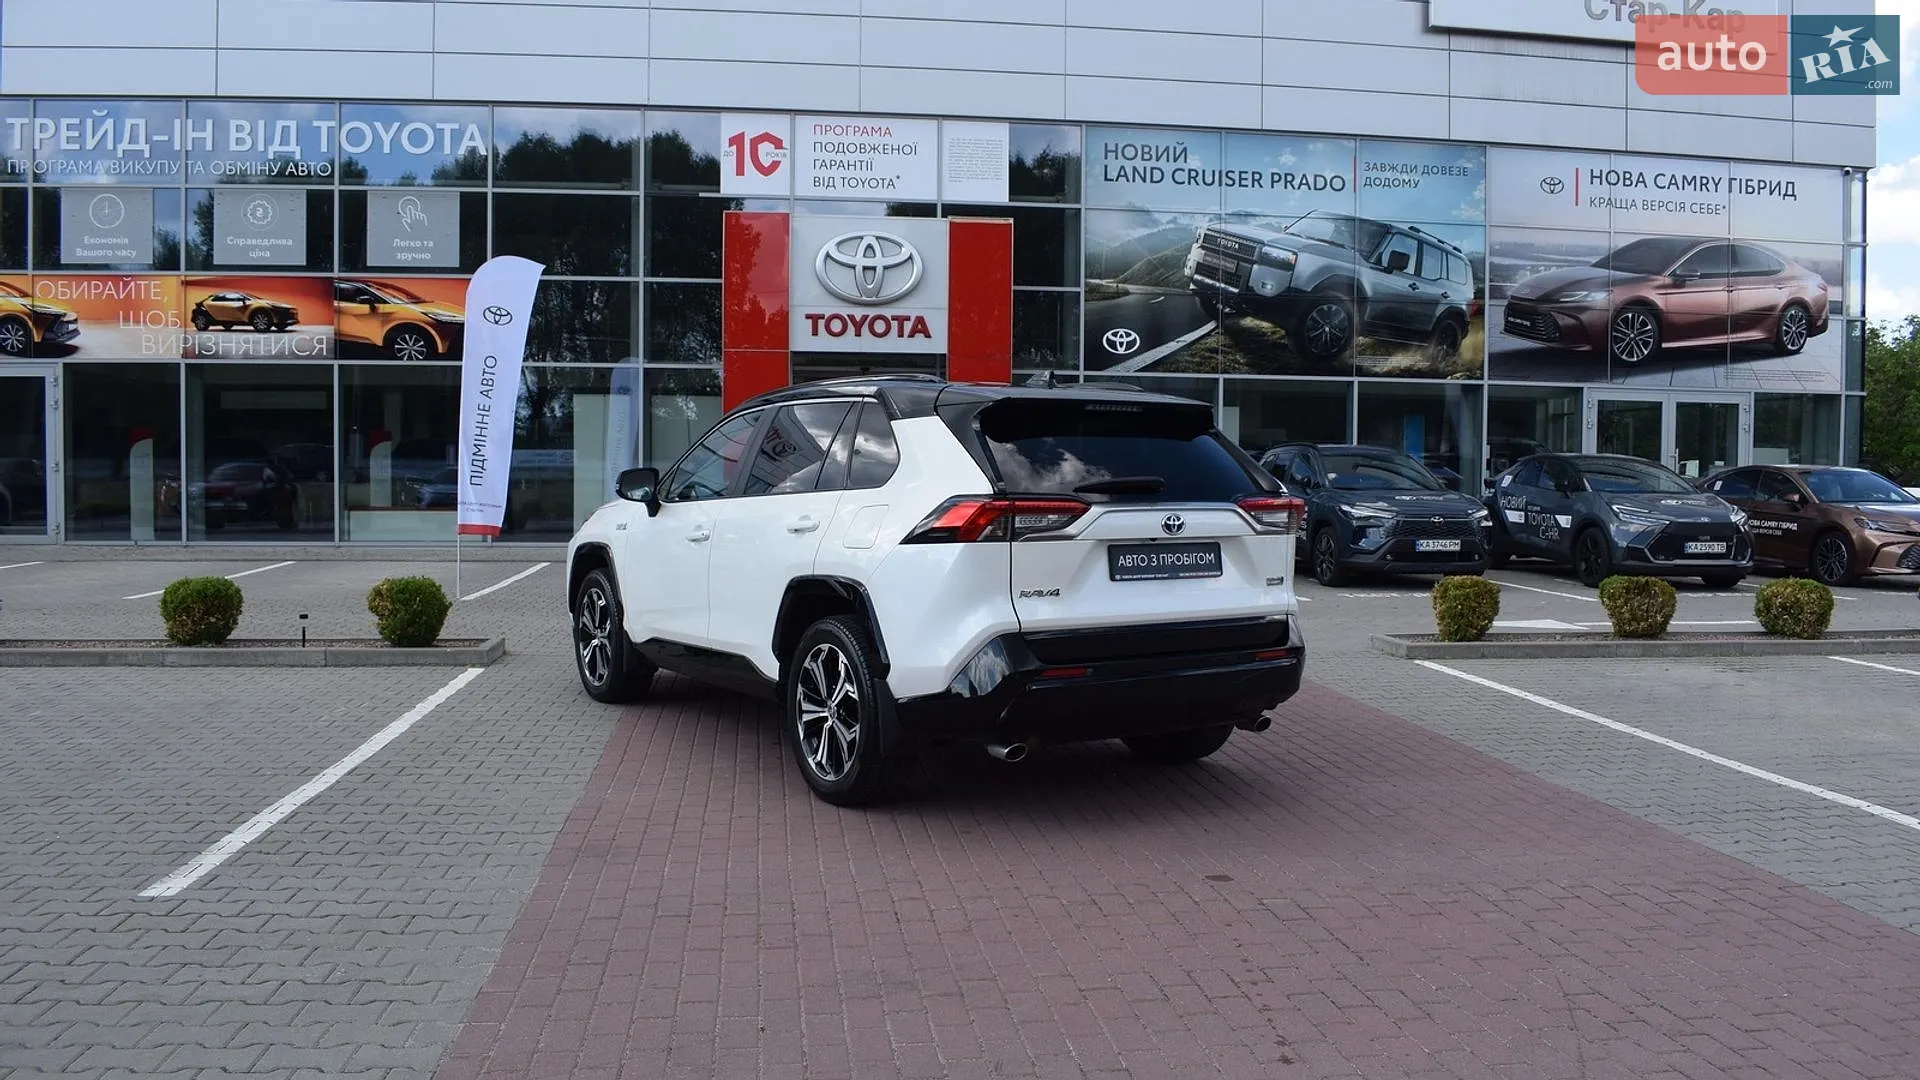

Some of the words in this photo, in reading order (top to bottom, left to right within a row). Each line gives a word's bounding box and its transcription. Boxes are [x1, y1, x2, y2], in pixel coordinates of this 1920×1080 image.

[6, 109, 213, 158] ТРЕЙД-ІН
[229, 119, 301, 159] ВІД
[313, 121, 488, 155] TOYOTA
[813, 124, 893, 137] ПРОГРАМА
[813, 141, 918, 156] ПОДОВЖЕНОЇ
[1103, 141, 1188, 163] НОВИЙ
[7, 159, 103, 174] ПРОГРАМА
[111, 160, 180, 175] ВИКУПУ
[186, 160, 205, 175] ТА
[211, 161, 281, 176] ОБМІНУ
[286, 161, 331, 176] АВТО
[813, 158, 874, 171] ГАРАНТІЇ
[1364, 161, 1418, 175] ЗАВЖДИ
[1421, 164, 1469, 176] ДОВЕЗЕ
[813, 176, 836, 189] ВІД
[1103, 164, 1164, 184] LAND
[1171, 168, 1263, 188] CRUISER
[1270, 172, 1346, 192] PRADO
[1363, 177, 1420, 189] ДОДОМУ
[1589, 169, 1647, 188] НОВА
[1653, 173, 1722, 193] CAMRY
[1728, 177, 1797, 200] ГІБРИД
[1589, 196, 1638, 211] КРАЩА
[1642, 199, 1686, 213] ВЕРСІЯ
[83, 235, 128, 245] Економія
[226, 236, 293, 247] Справедлива
[393, 238, 420, 248] Легко
[76, 248, 113, 258] Вашого
[114, 249, 137, 259] часу
[249, 249, 271, 259] ціна
[396, 252, 431, 261] зручно
[35, 276, 168, 302] ОБИРАЙТЕ,
[119, 311, 180, 330] ЩОБ
[805, 313, 932, 338] TOYOTA
[142, 334, 327, 356] ВИРІЗНЯТИСЯ
[479, 355, 498, 399] АВТО
[469, 403, 491, 487] ПІДМІННЕ
[1500, 496, 1527, 509] НОВИЙ
[1528, 512, 1556, 526] TOYOTA
[1118, 554, 1148, 567] АВТО
[1150, 554, 1157, 566] З
[1160, 552, 1215, 566] ПРОБІГОМ
[1018, 588, 1061, 598] RAV4
